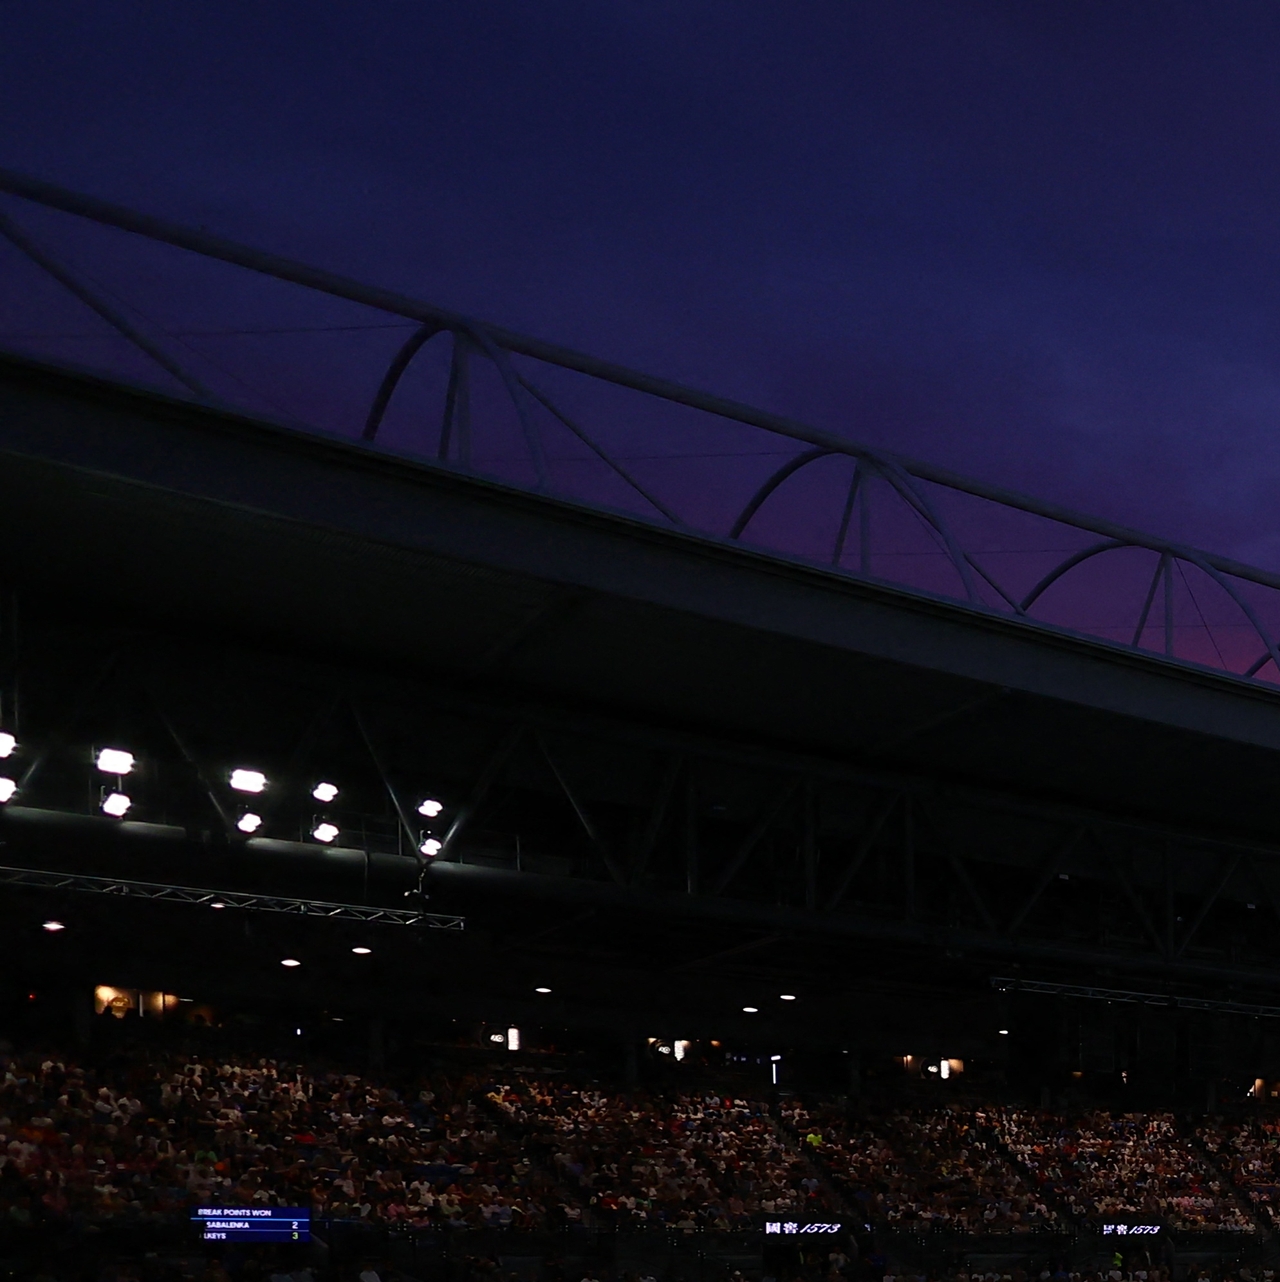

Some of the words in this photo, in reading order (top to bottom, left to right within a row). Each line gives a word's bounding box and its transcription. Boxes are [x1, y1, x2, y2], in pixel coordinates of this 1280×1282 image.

[197, 1208, 222, 1216] BREAK
[224, 1208, 251, 1217] POINTS
[251, 1209, 272, 1217] WON
[291, 1221, 299, 1230] 2
[291, 1231, 299, 1240] 3
